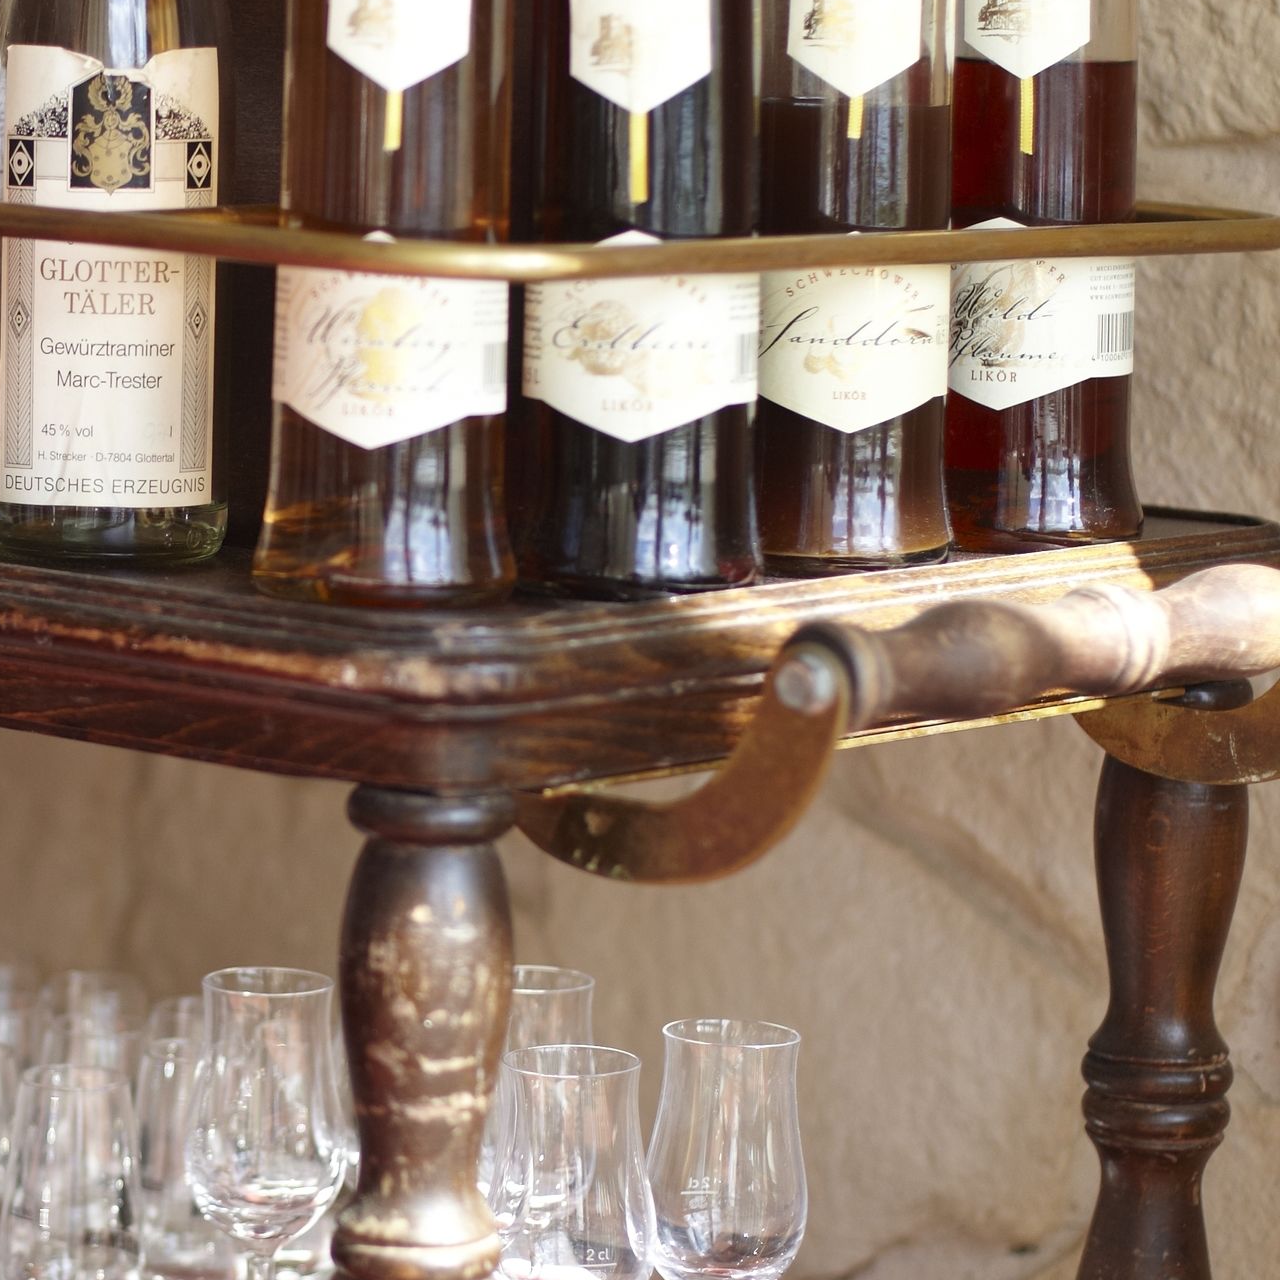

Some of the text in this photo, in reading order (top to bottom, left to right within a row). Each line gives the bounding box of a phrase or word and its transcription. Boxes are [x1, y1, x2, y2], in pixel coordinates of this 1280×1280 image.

[40, 257, 180, 284] GLOTTER-
[63, 289, 156, 315] TÄLER
[40, 336, 175, 357] Gewürztraminer
[56, 370, 163, 389] Marc-Trester
[971, 369, 1018, 383] LIKÖR
[832, 390, 867, 401] LIKÖR
[41, 423, 56, 436] 45
[59, 424, 71, 437] %
[75, 425, 94, 438] vol
[37, 451, 175, 463] H. Strecker D-7804 Glottertal
[5, 475, 205, 495] DEUTSCHES ERZEUGNIS
[586, 1248, 610, 1261] 2 cl
